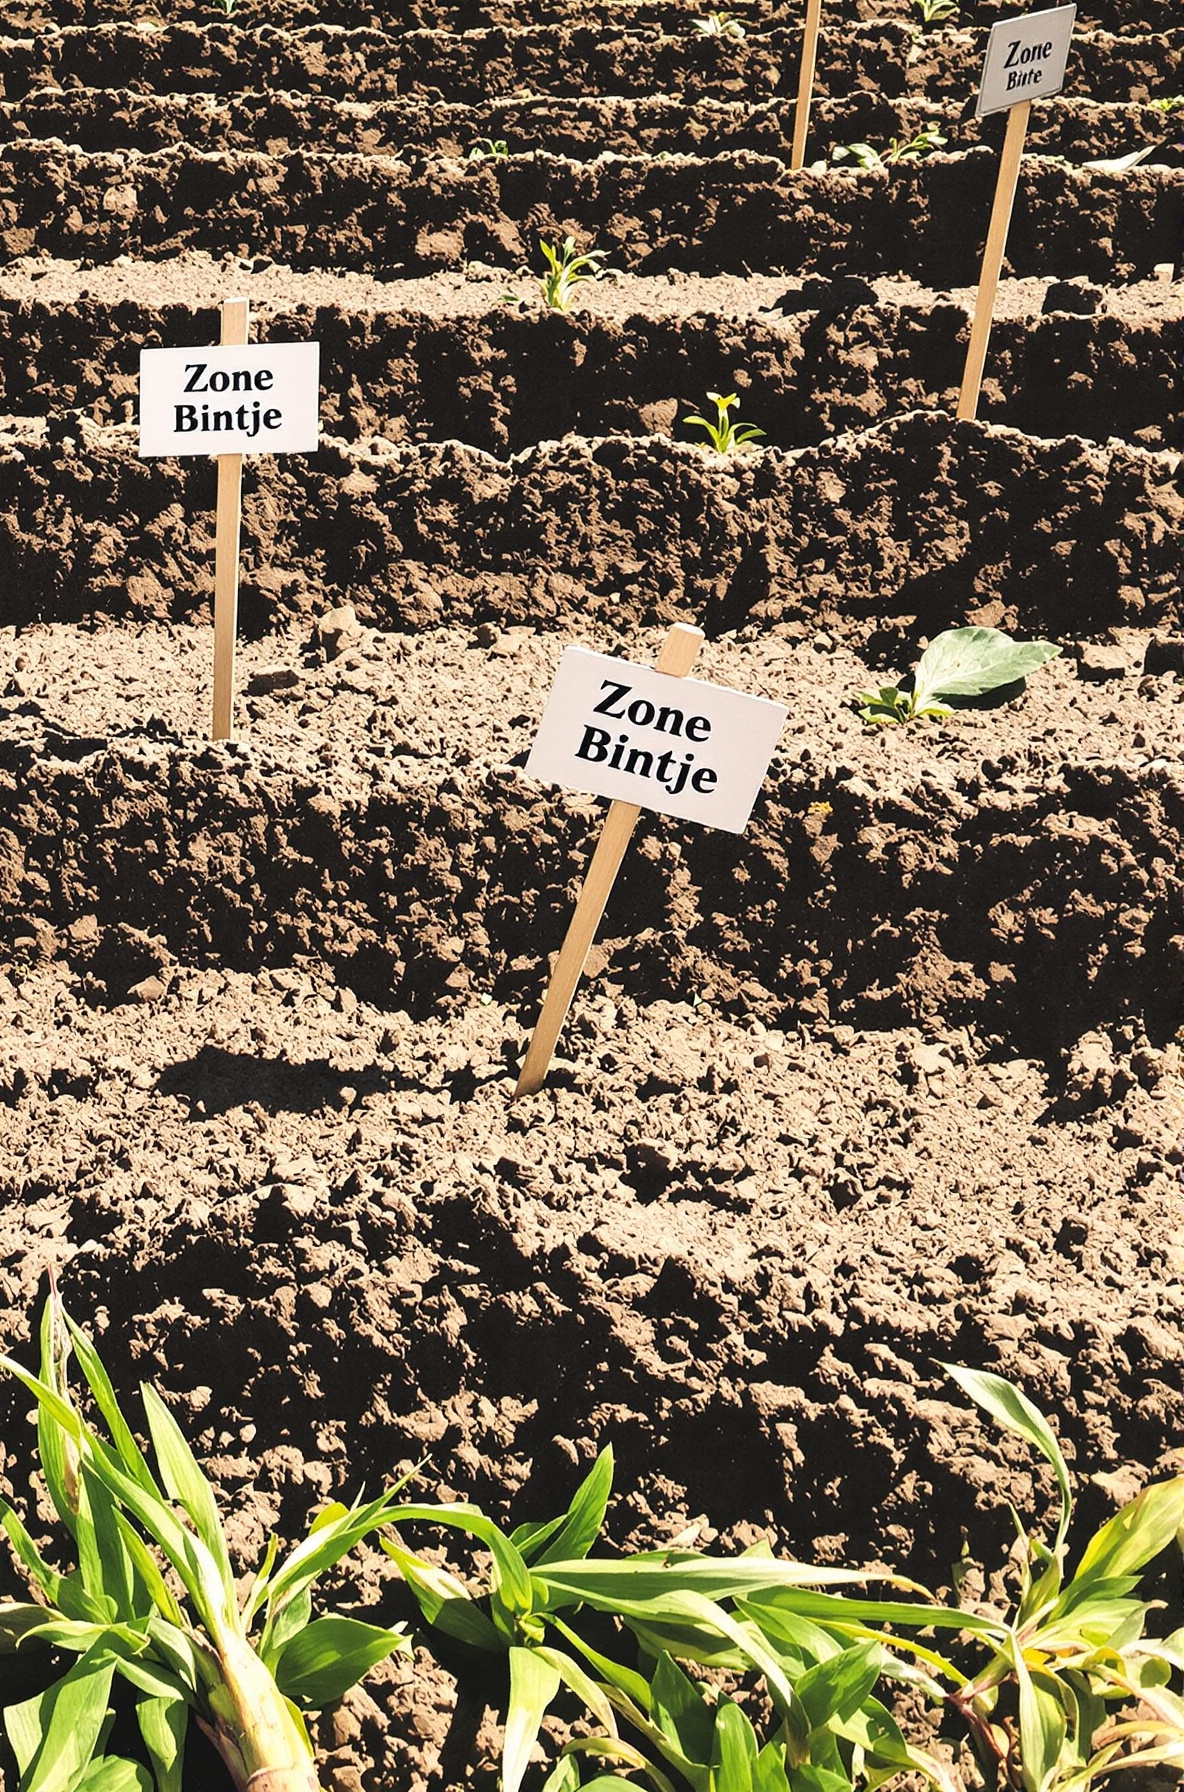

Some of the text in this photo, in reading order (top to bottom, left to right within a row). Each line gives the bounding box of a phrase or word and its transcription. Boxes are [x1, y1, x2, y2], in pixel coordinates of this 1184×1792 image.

[1003, 41, 1053, 69] Zone
[183, 363, 274, 393] Zone
[173, 401, 282, 438] Bintje
[592, 679, 712, 743] Zone
[574, 724, 718, 795] Bintje
